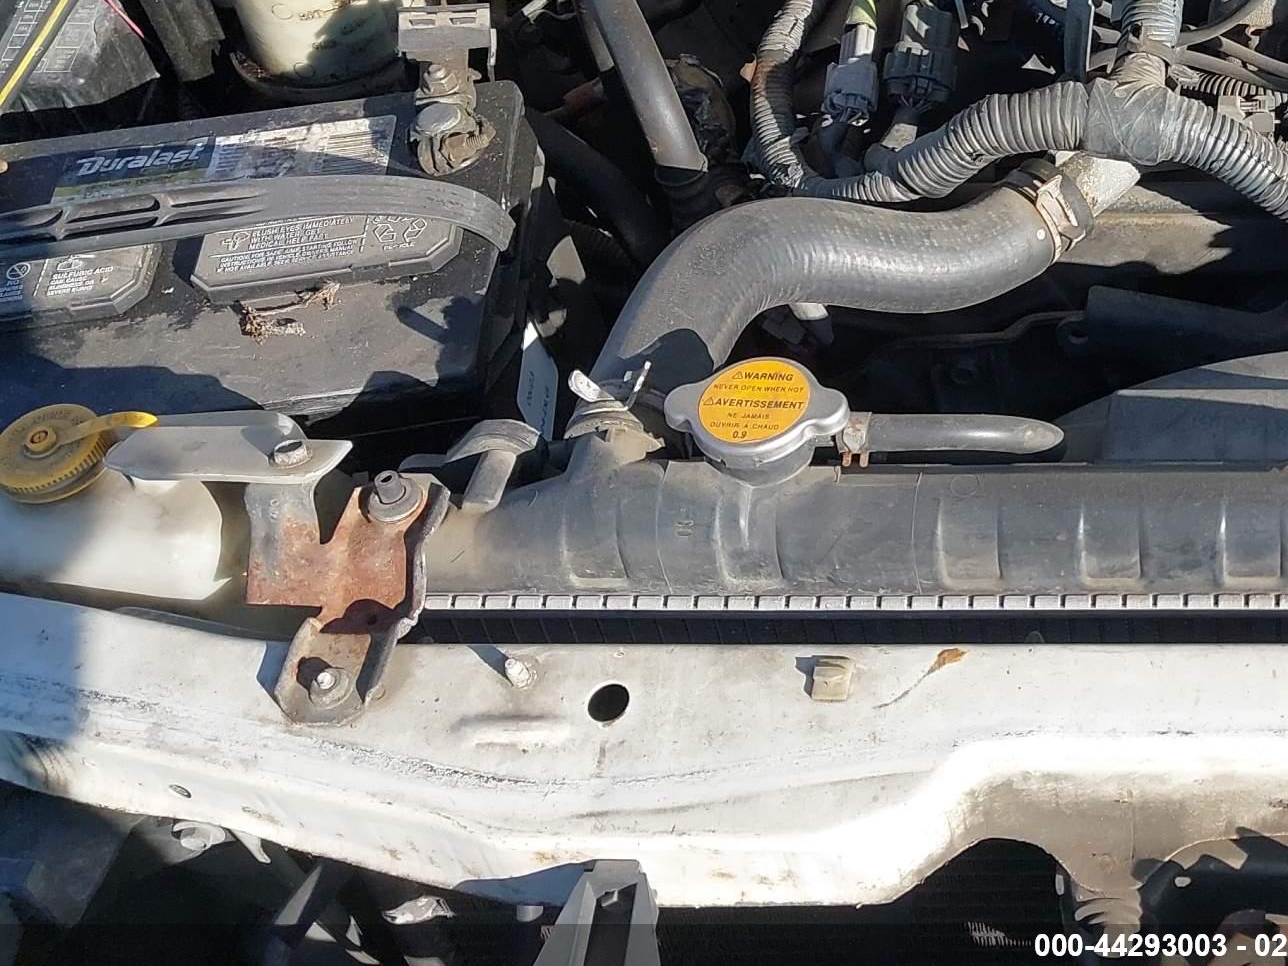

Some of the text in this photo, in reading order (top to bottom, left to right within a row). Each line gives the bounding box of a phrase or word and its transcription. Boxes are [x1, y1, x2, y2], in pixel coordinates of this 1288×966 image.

[76, 142, 206, 177] Duralast
[280, 224, 300, 234] EYES
[52, 265, 114, 280] SULFURIC ACID
[744, 371, 794, 382] WARNING
[713, 383, 739, 391] NEVER
[741, 384, 761, 392] OPEN
[714, 397, 805, 410] AVERTISSEMENT
[709, 421, 740, 429] OUVRIR
[751, 423, 780, 431] CHAUD
[732, 430, 748, 439] 0.9
